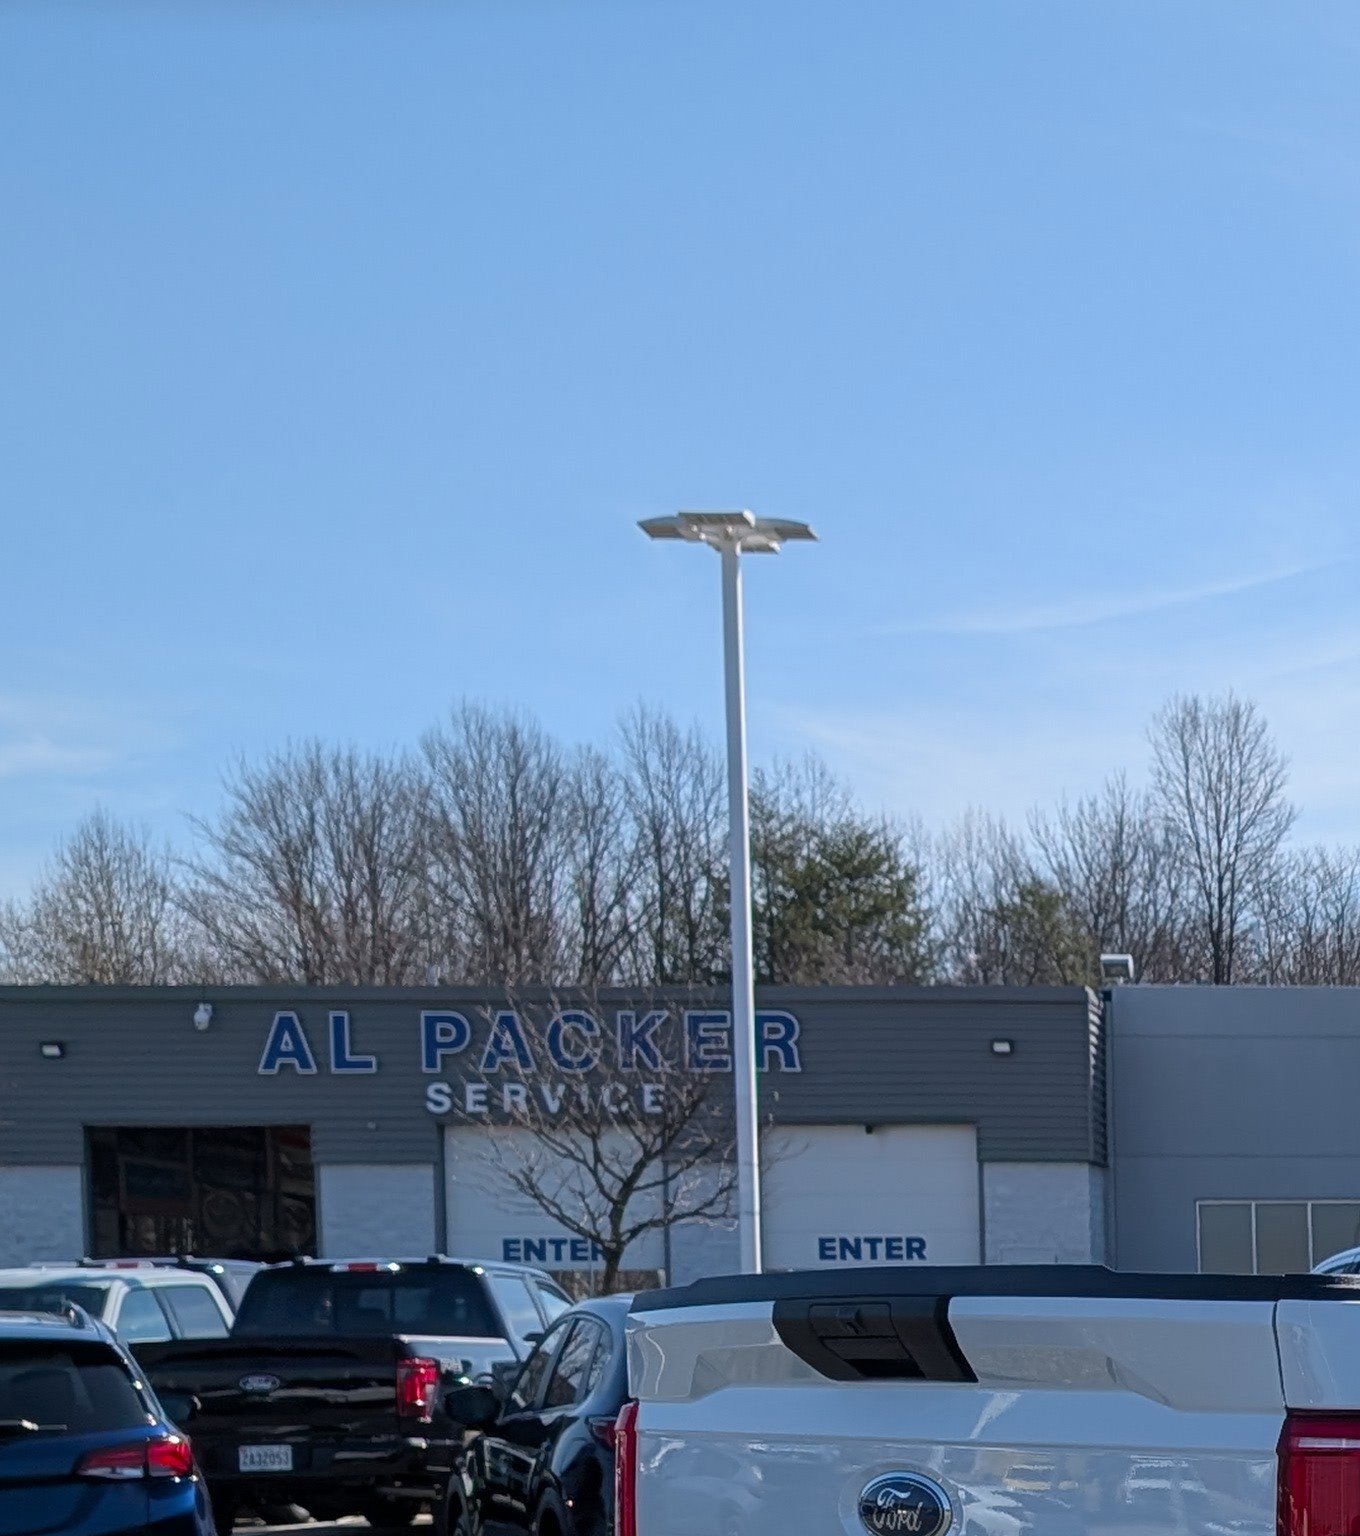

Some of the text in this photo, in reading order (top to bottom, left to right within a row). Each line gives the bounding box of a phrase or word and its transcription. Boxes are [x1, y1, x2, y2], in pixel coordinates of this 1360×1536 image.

[258, 1010, 801, 1074] AL PACKER
[426, 1082, 665, 1114] SERVICE
[818, 1236, 927, 1261] ENTER
[873, 1487, 924, 1531] Ford
